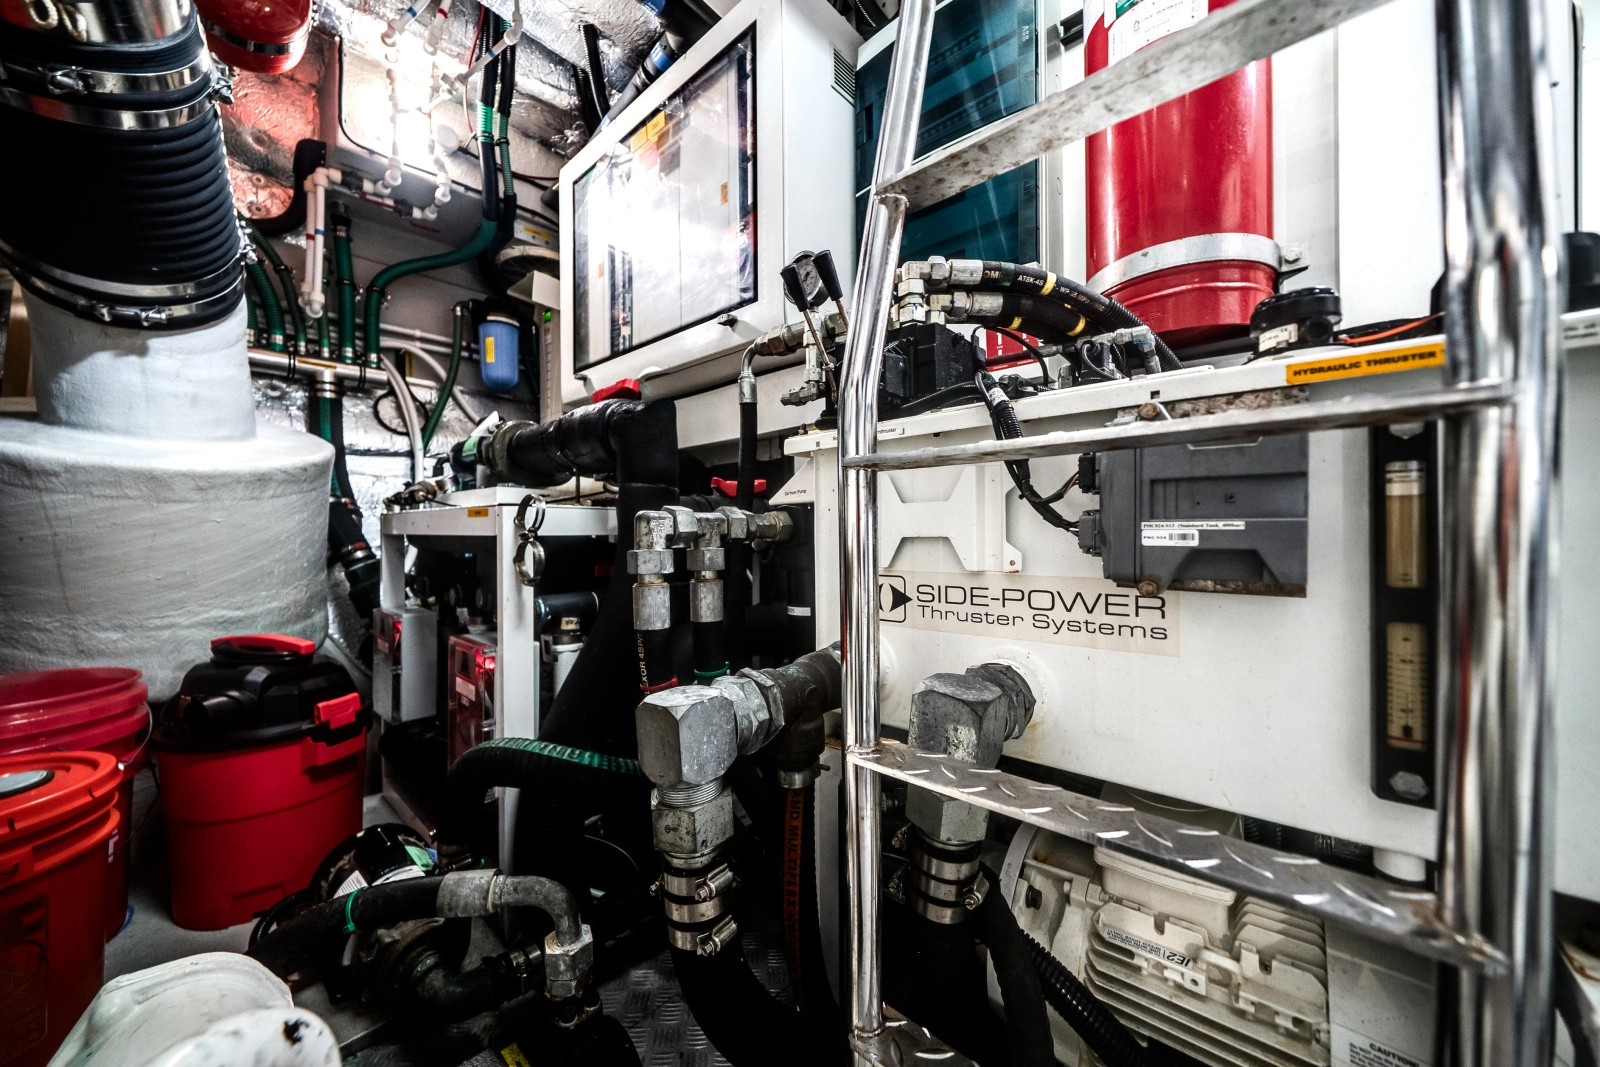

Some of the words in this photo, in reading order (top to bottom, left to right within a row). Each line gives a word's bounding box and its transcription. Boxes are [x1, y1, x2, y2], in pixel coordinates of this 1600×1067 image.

[1293, 361, 1362, 377] HYDRAULIC
[1365, 350, 1437, 367] THRUSTER
[916, 584, 1167, 620] SIDE-POWER
[917, 604, 1024, 627] Thruster
[1032, 613, 1169, 640] Systems
[1166, 951, 1191, 968] IE2
